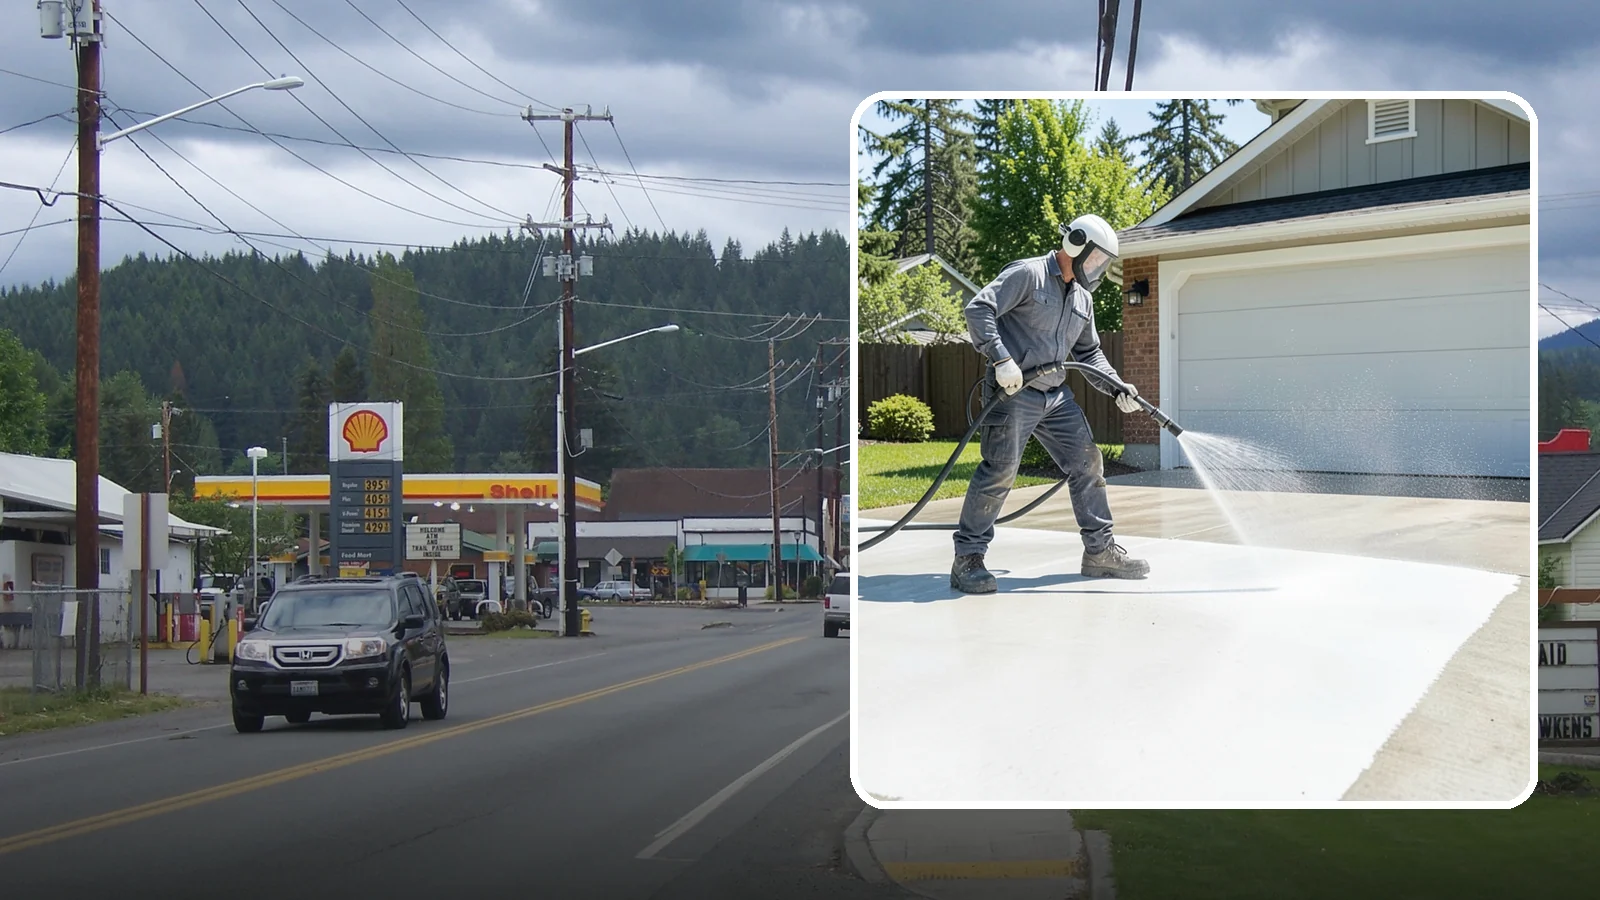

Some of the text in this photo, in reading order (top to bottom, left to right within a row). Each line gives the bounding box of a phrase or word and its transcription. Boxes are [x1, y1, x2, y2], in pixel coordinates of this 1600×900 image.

[365, 480, 384, 490] 395
[490, 484, 547, 499] Shell
[365, 494, 384, 504] 405
[365, 508, 384, 518] 415
[365, 522, 384, 533] 429
